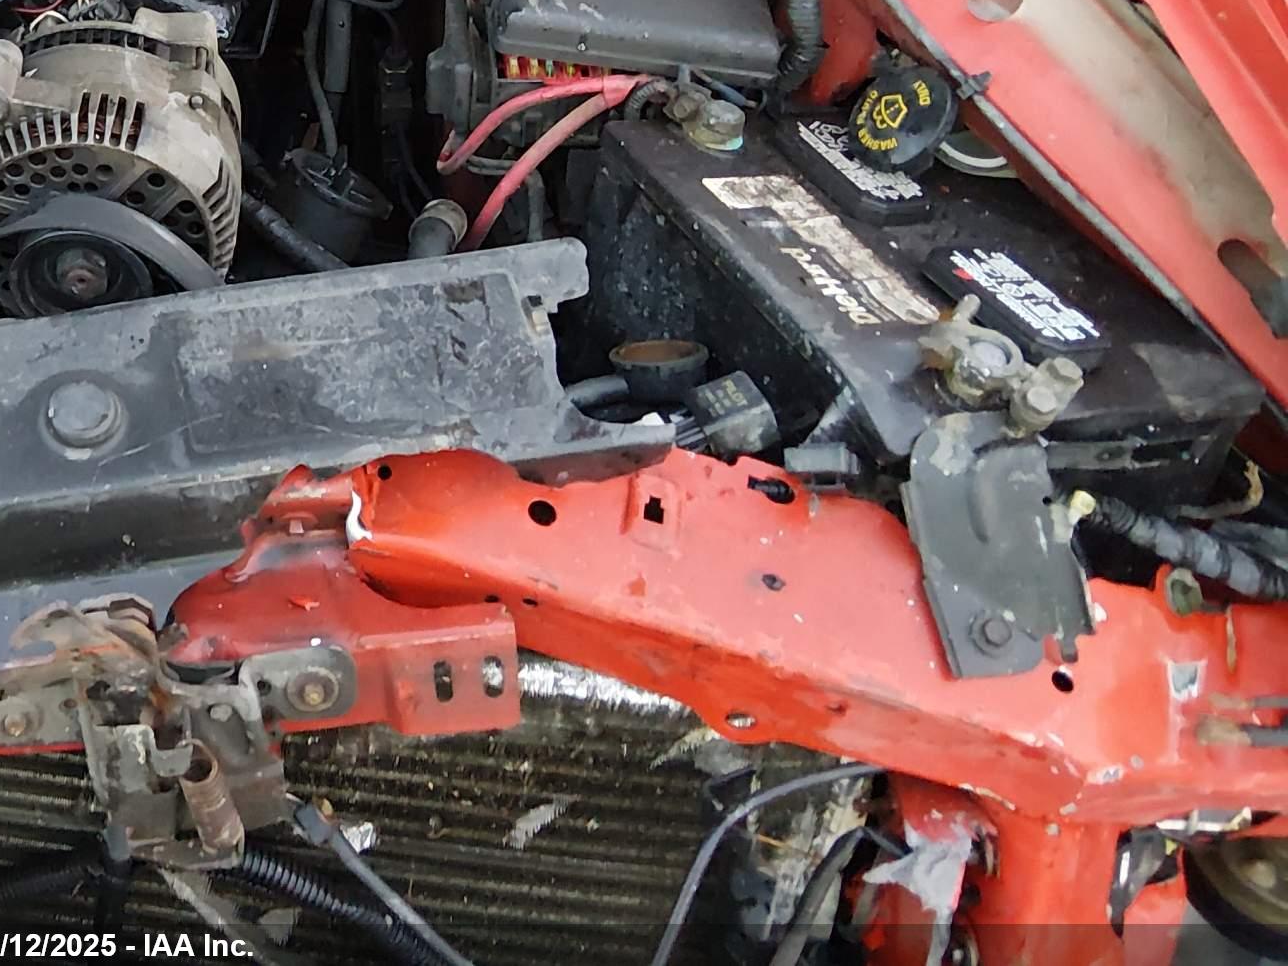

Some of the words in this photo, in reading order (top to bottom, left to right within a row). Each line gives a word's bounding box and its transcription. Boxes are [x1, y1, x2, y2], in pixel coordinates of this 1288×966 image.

[913, 80, 931, 106] ONLY
[858, 128, 897, 150] WASHER
[779, 247, 882, 324] DieHard
